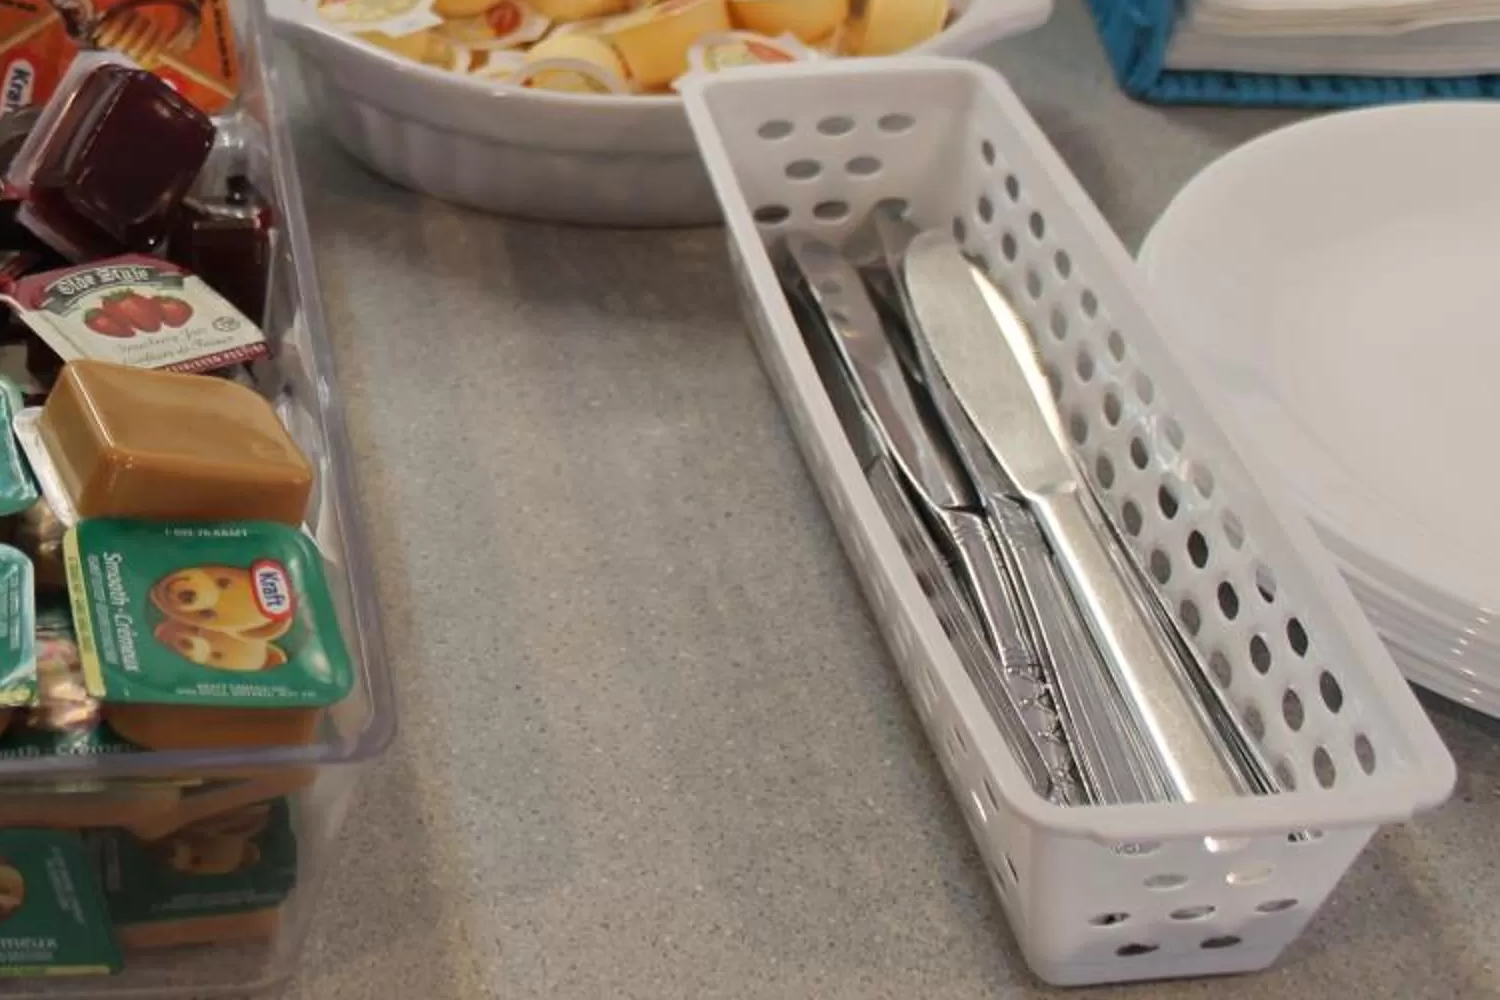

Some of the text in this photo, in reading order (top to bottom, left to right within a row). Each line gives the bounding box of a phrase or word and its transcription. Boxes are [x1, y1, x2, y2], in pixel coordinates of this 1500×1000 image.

[103, 551, 142, 674] Smooth Crémeux
[259, 571, 287, 609] Kraft
